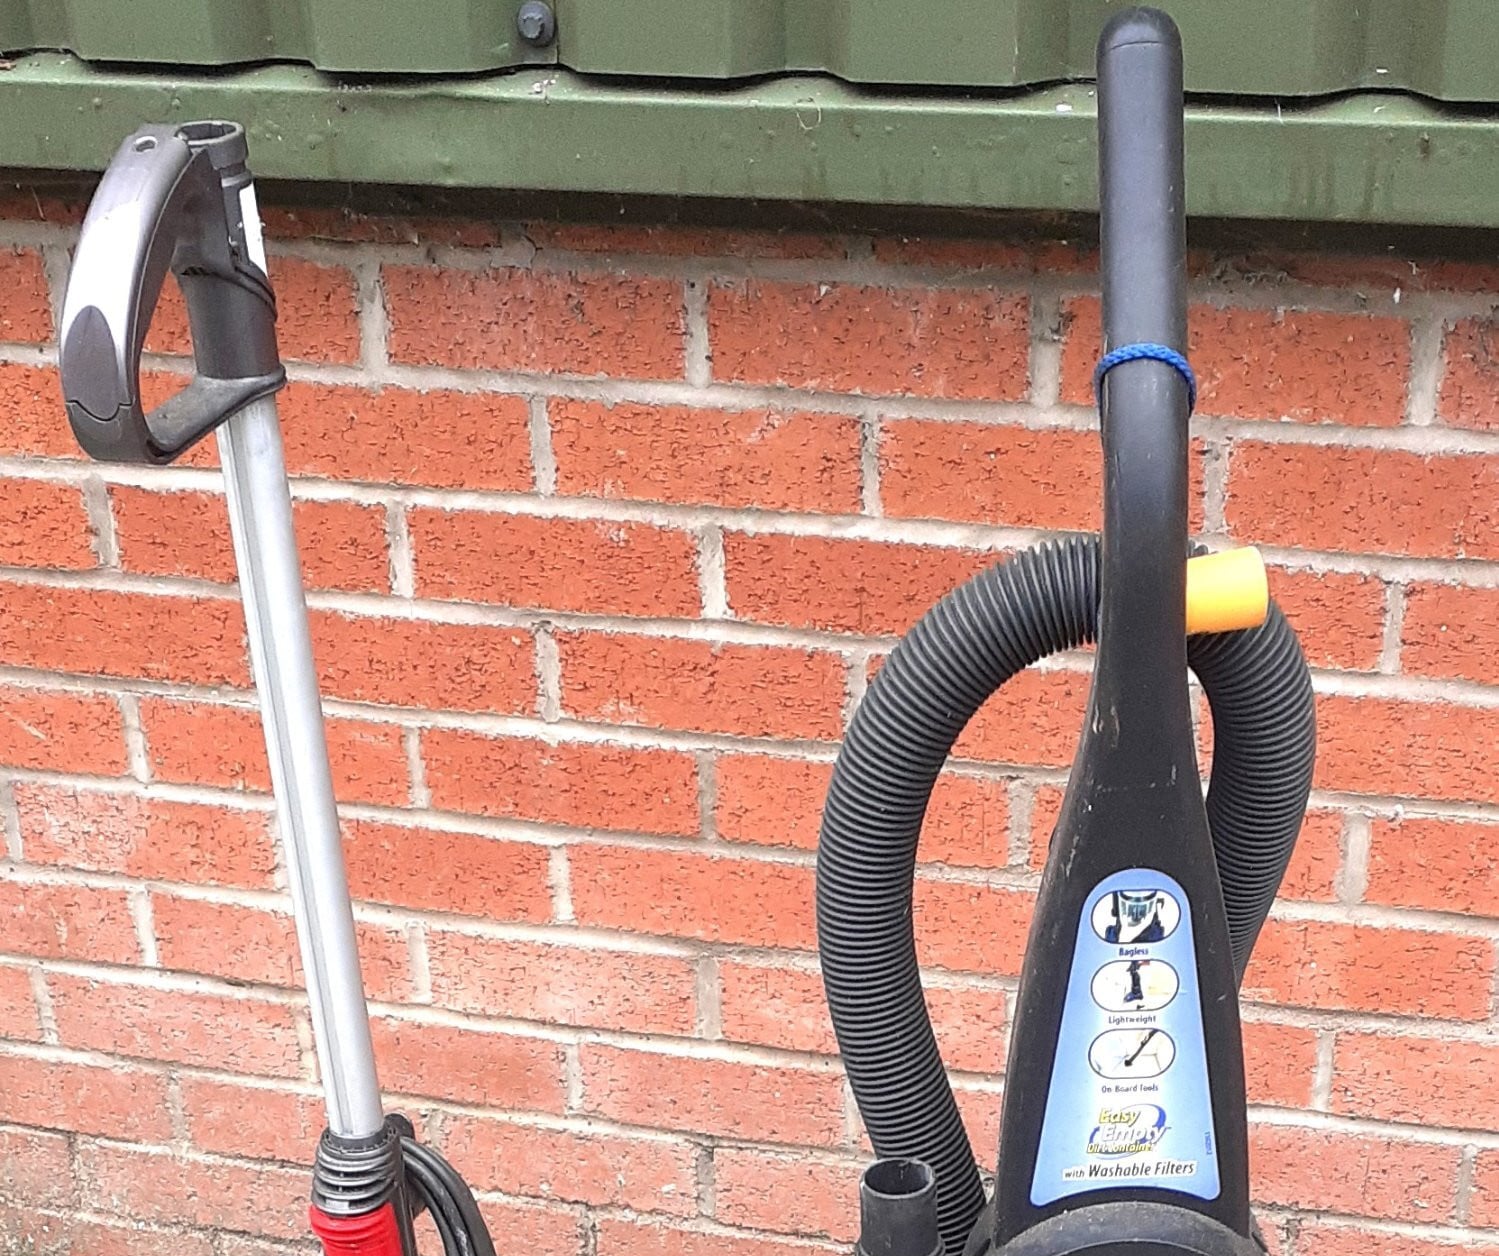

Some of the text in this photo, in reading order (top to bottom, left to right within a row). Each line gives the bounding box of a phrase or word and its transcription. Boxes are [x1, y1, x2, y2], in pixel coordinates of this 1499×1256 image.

[1119, 947, 1149, 957] Bagless
[1108, 1015, 1156, 1025] Lightweight
[1140, 1083, 1159, 1092] Tools
[1099, 1108, 1141, 1127] Easy
[1102, 1124, 1167, 1145] Empty
[1065, 1161, 1194, 1179] with Washable Filters
